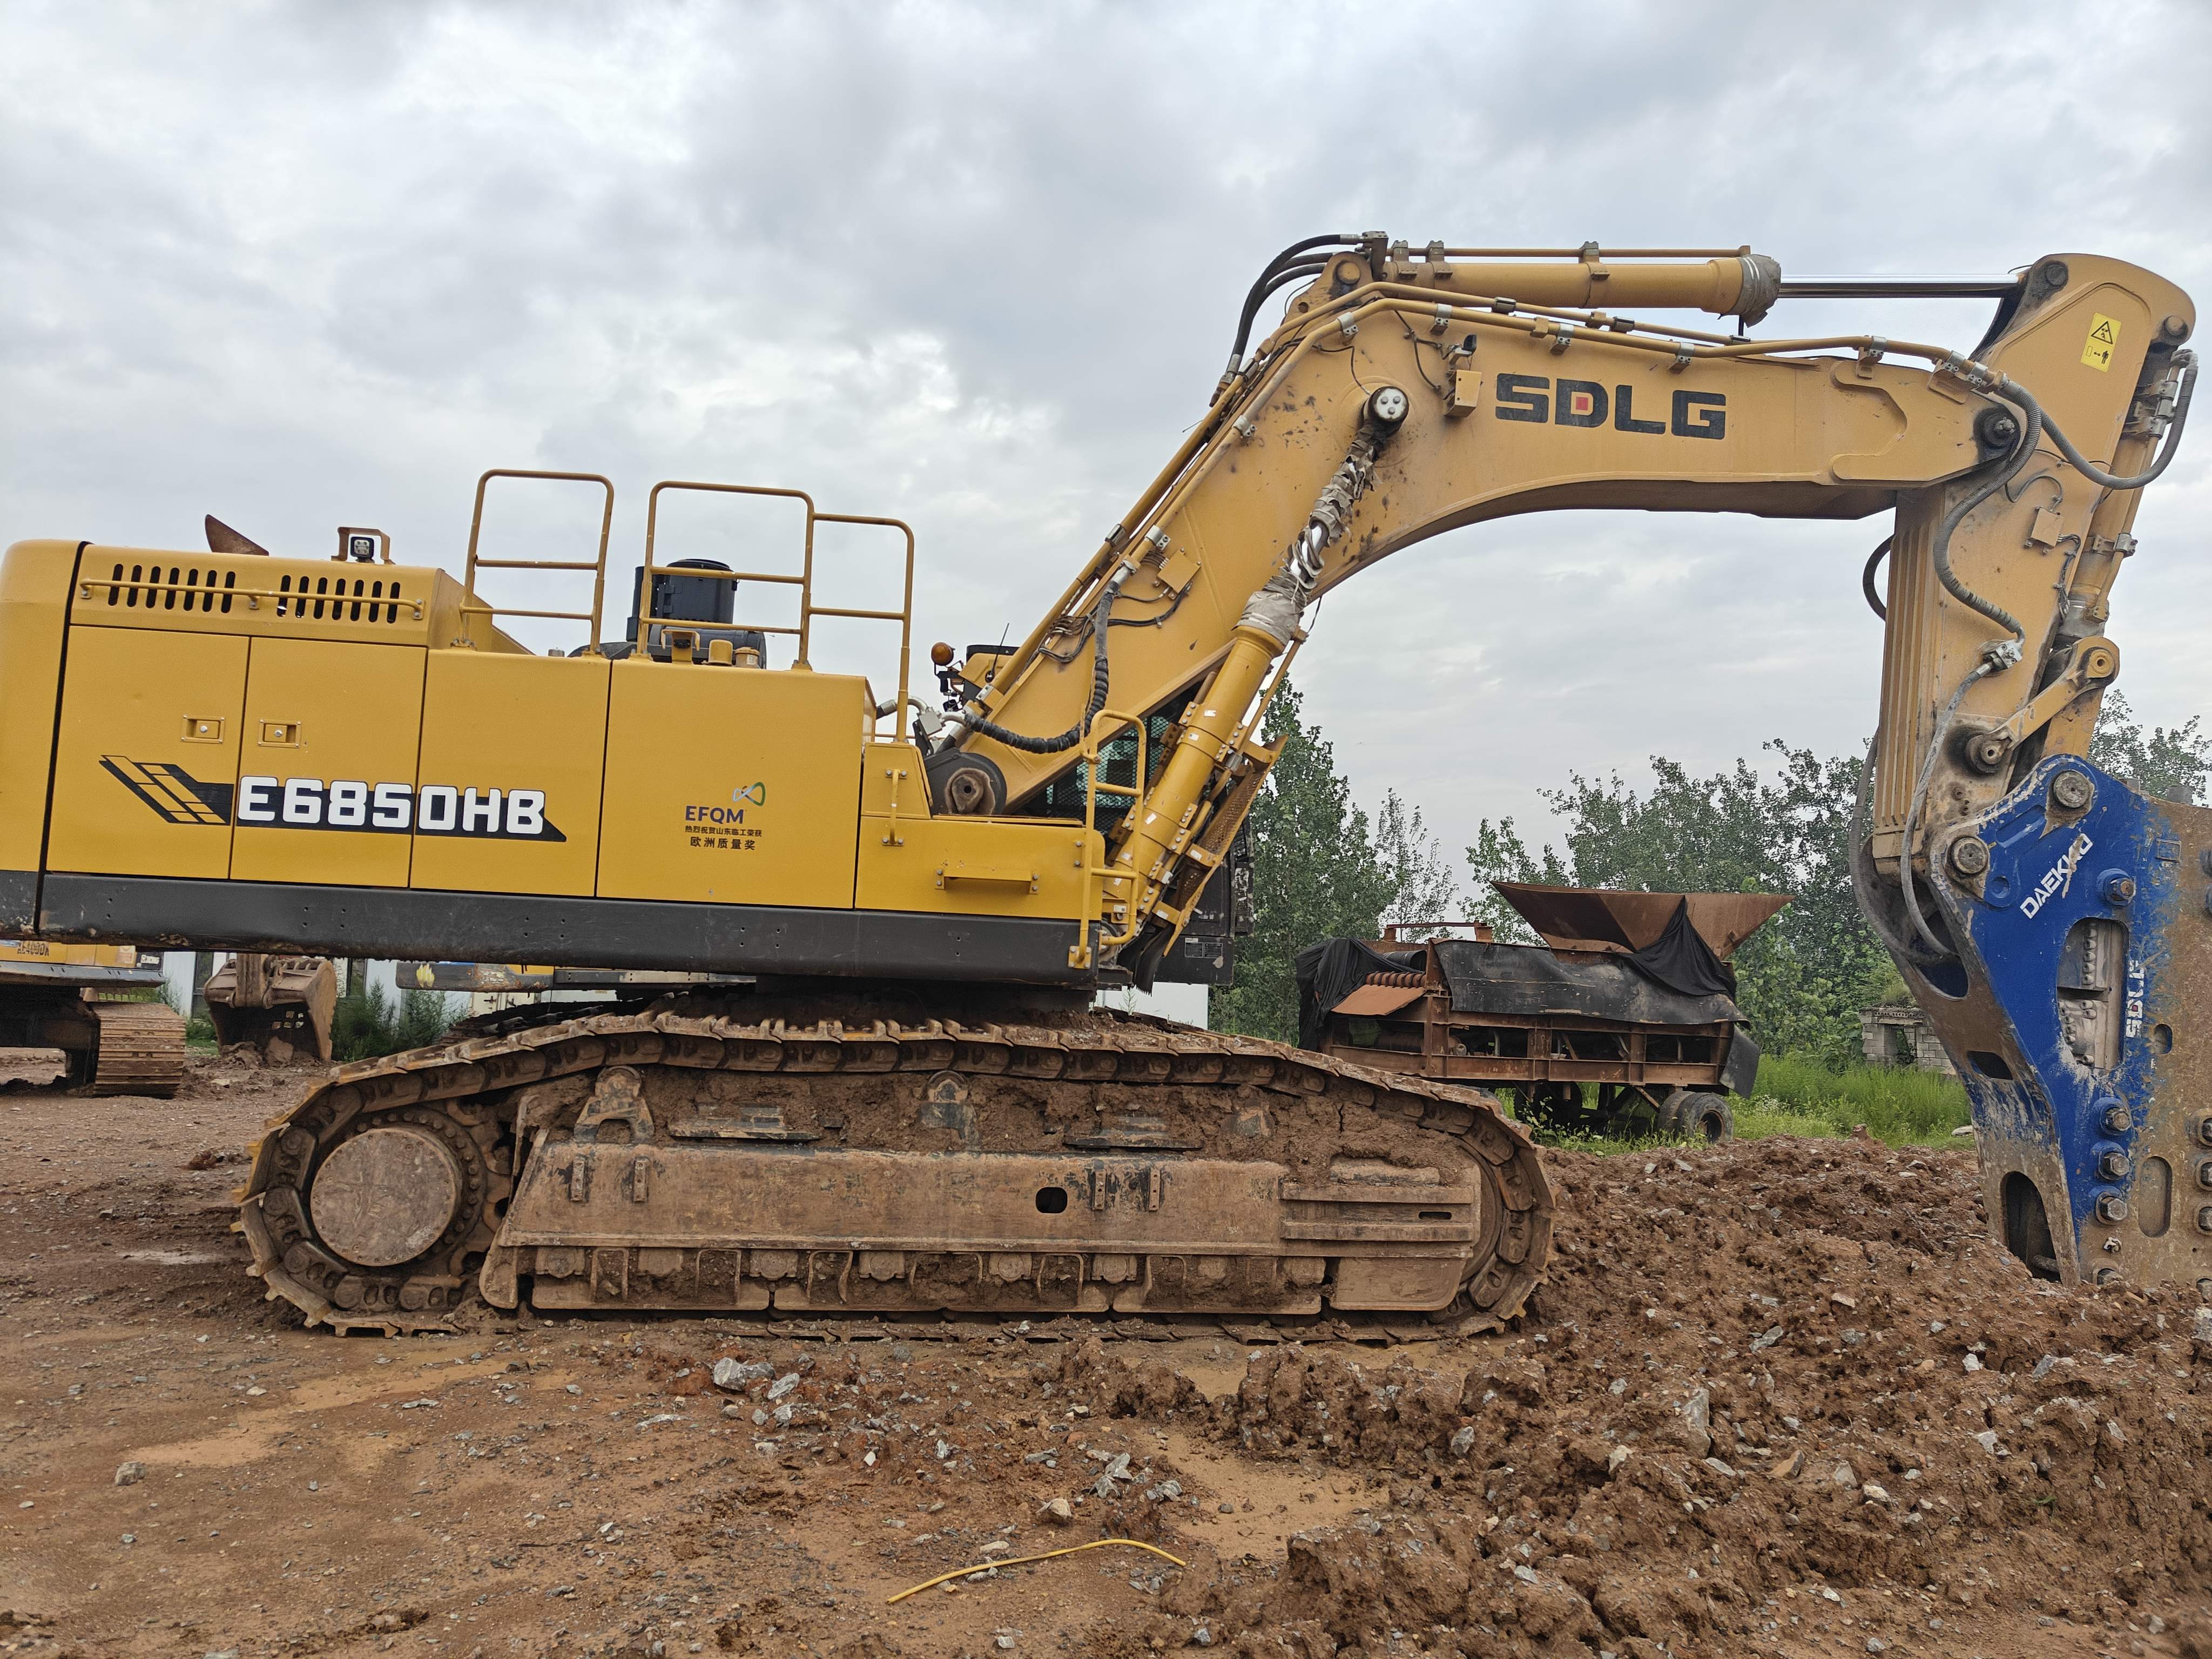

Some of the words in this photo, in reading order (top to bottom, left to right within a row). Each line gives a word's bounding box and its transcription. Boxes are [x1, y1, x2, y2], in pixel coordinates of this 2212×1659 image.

[1495, 373, 1726, 440] SDLG
[238, 776, 545, 834] E6850HB
[685, 806, 744, 824] EFQM
[685, 825, 763, 837] 热烈祝贺山东临工荣获
[690, 836, 756, 851] 欧洲质量奖
